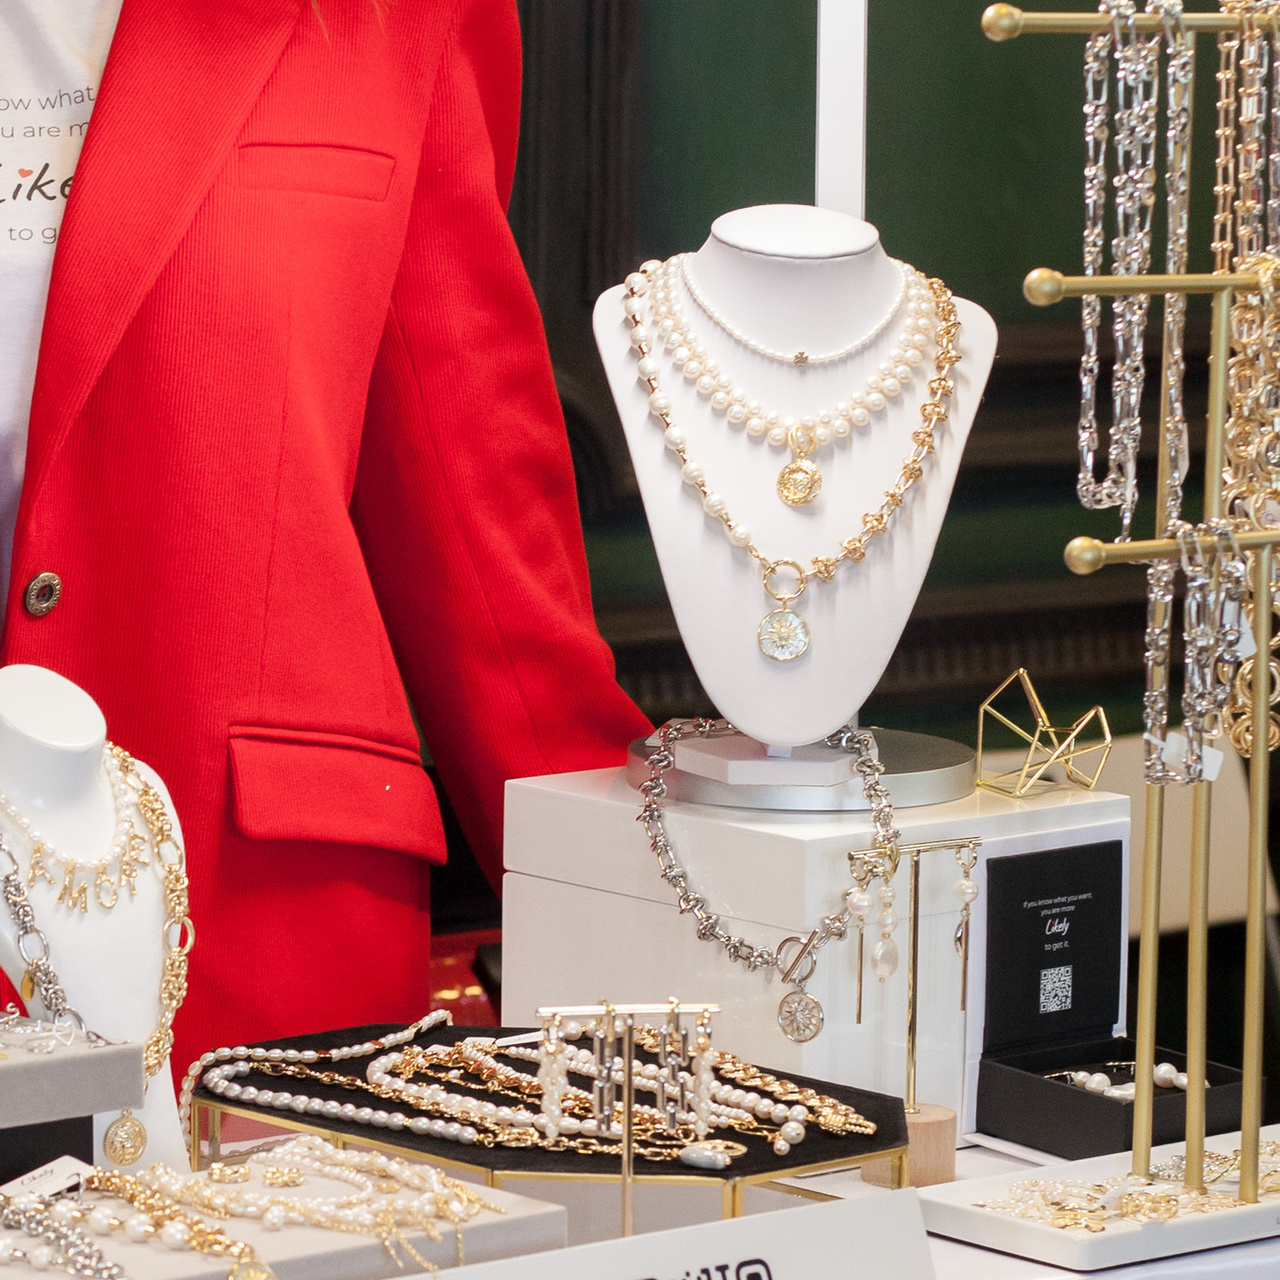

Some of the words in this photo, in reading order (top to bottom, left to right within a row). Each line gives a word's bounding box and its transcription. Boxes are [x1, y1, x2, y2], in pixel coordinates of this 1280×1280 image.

[37, 86, 96, 110] what
[23, 126, 61, 138] are
[8, 226, 33, 241] to
[1045, 917, 1070, 936] Likely
